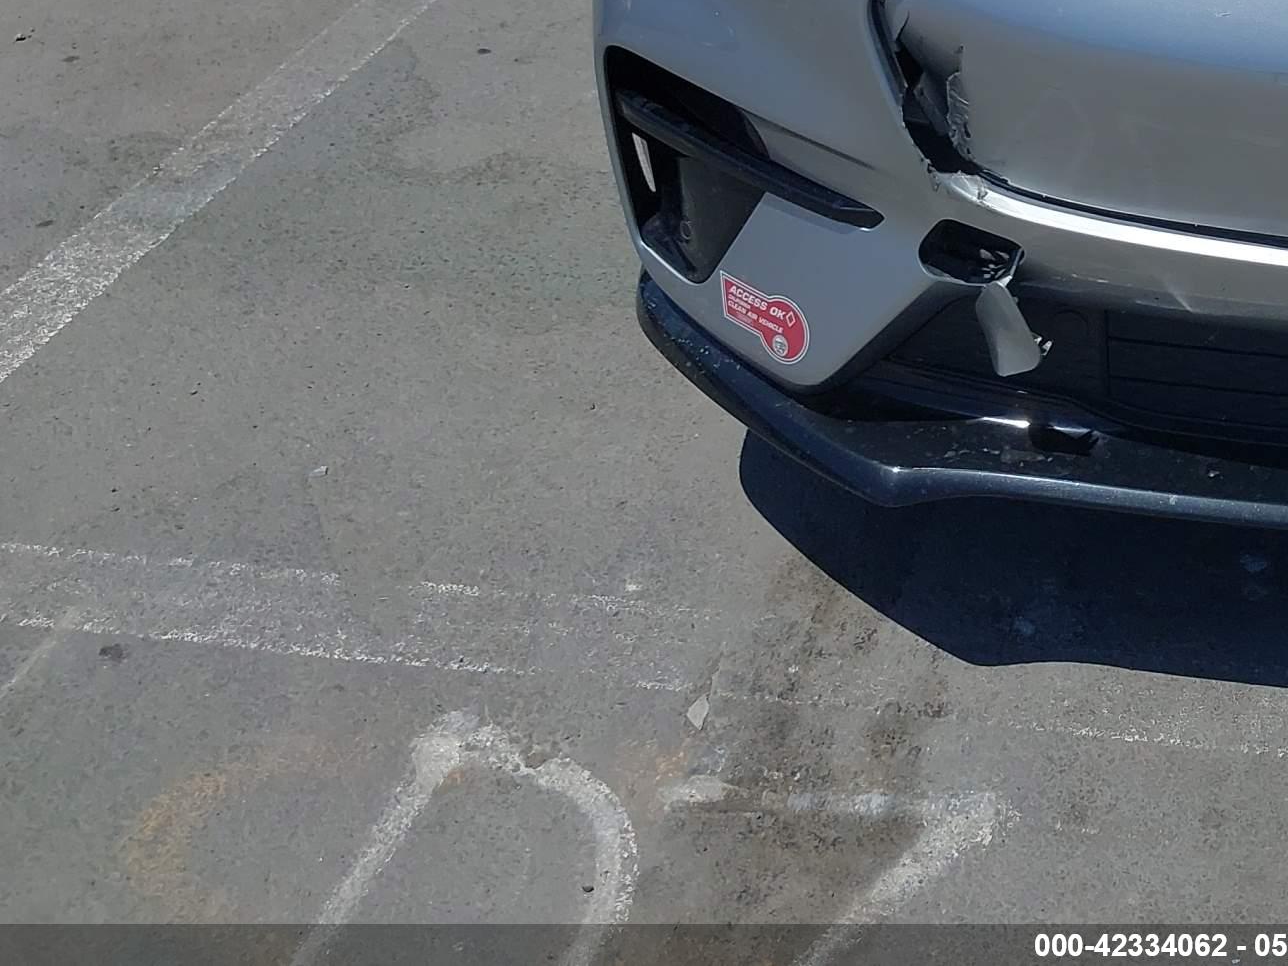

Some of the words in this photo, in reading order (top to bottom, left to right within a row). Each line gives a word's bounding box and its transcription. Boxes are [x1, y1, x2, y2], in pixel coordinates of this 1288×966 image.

[727, 300, 747, 315] CLEAN
[758, 316, 784, 334] VEHICLE
[728, 285, 768, 311] ACCESS
[769, 306, 786, 320] OK
